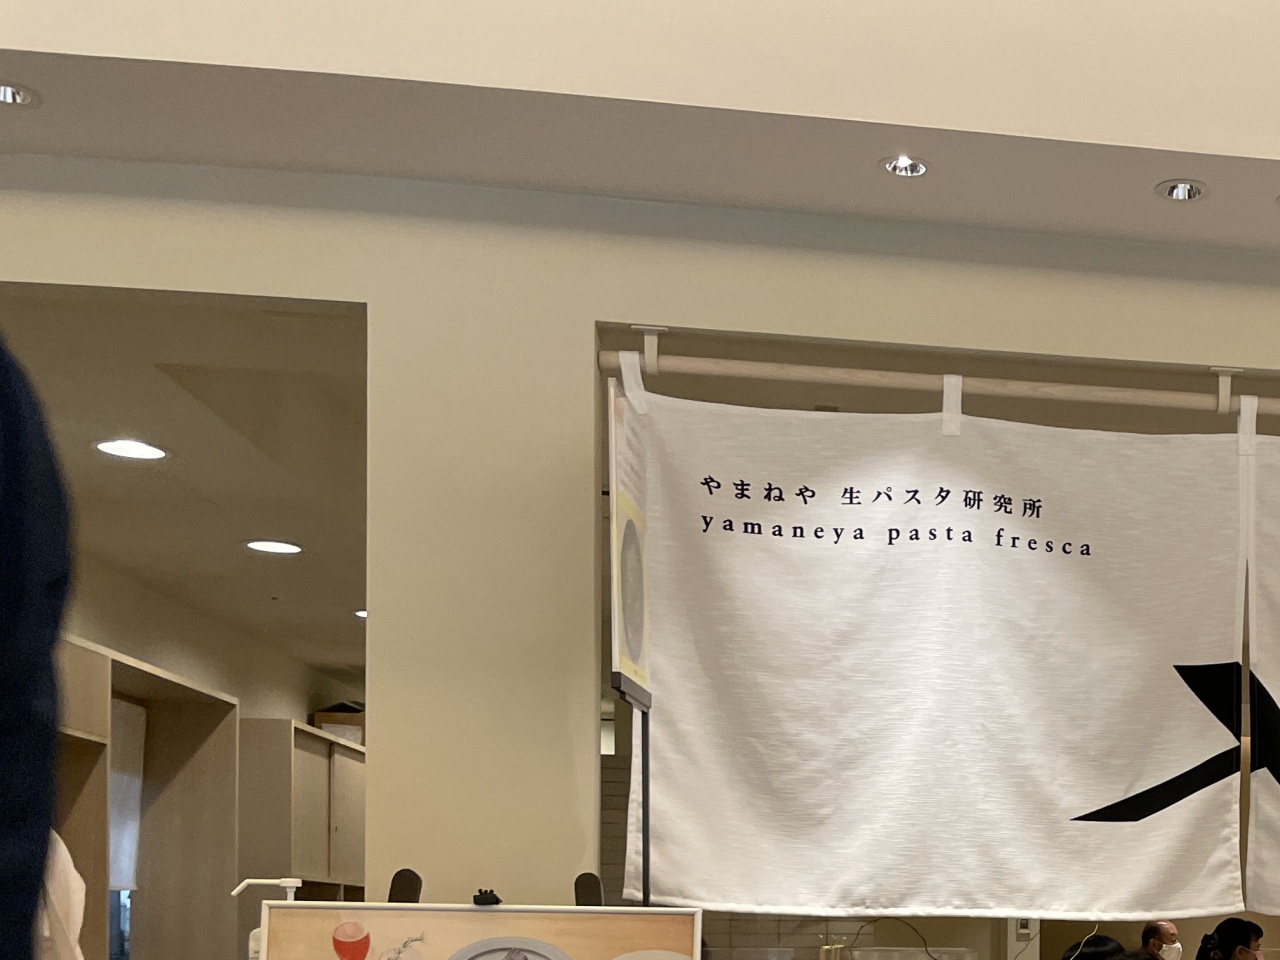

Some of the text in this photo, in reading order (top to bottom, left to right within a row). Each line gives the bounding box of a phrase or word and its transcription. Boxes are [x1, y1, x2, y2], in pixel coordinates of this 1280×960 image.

[700, 474, 1043, 519] やまねや 生パスタ研究所
[700, 514, 1092, 557] yamaneya pasta fresca
